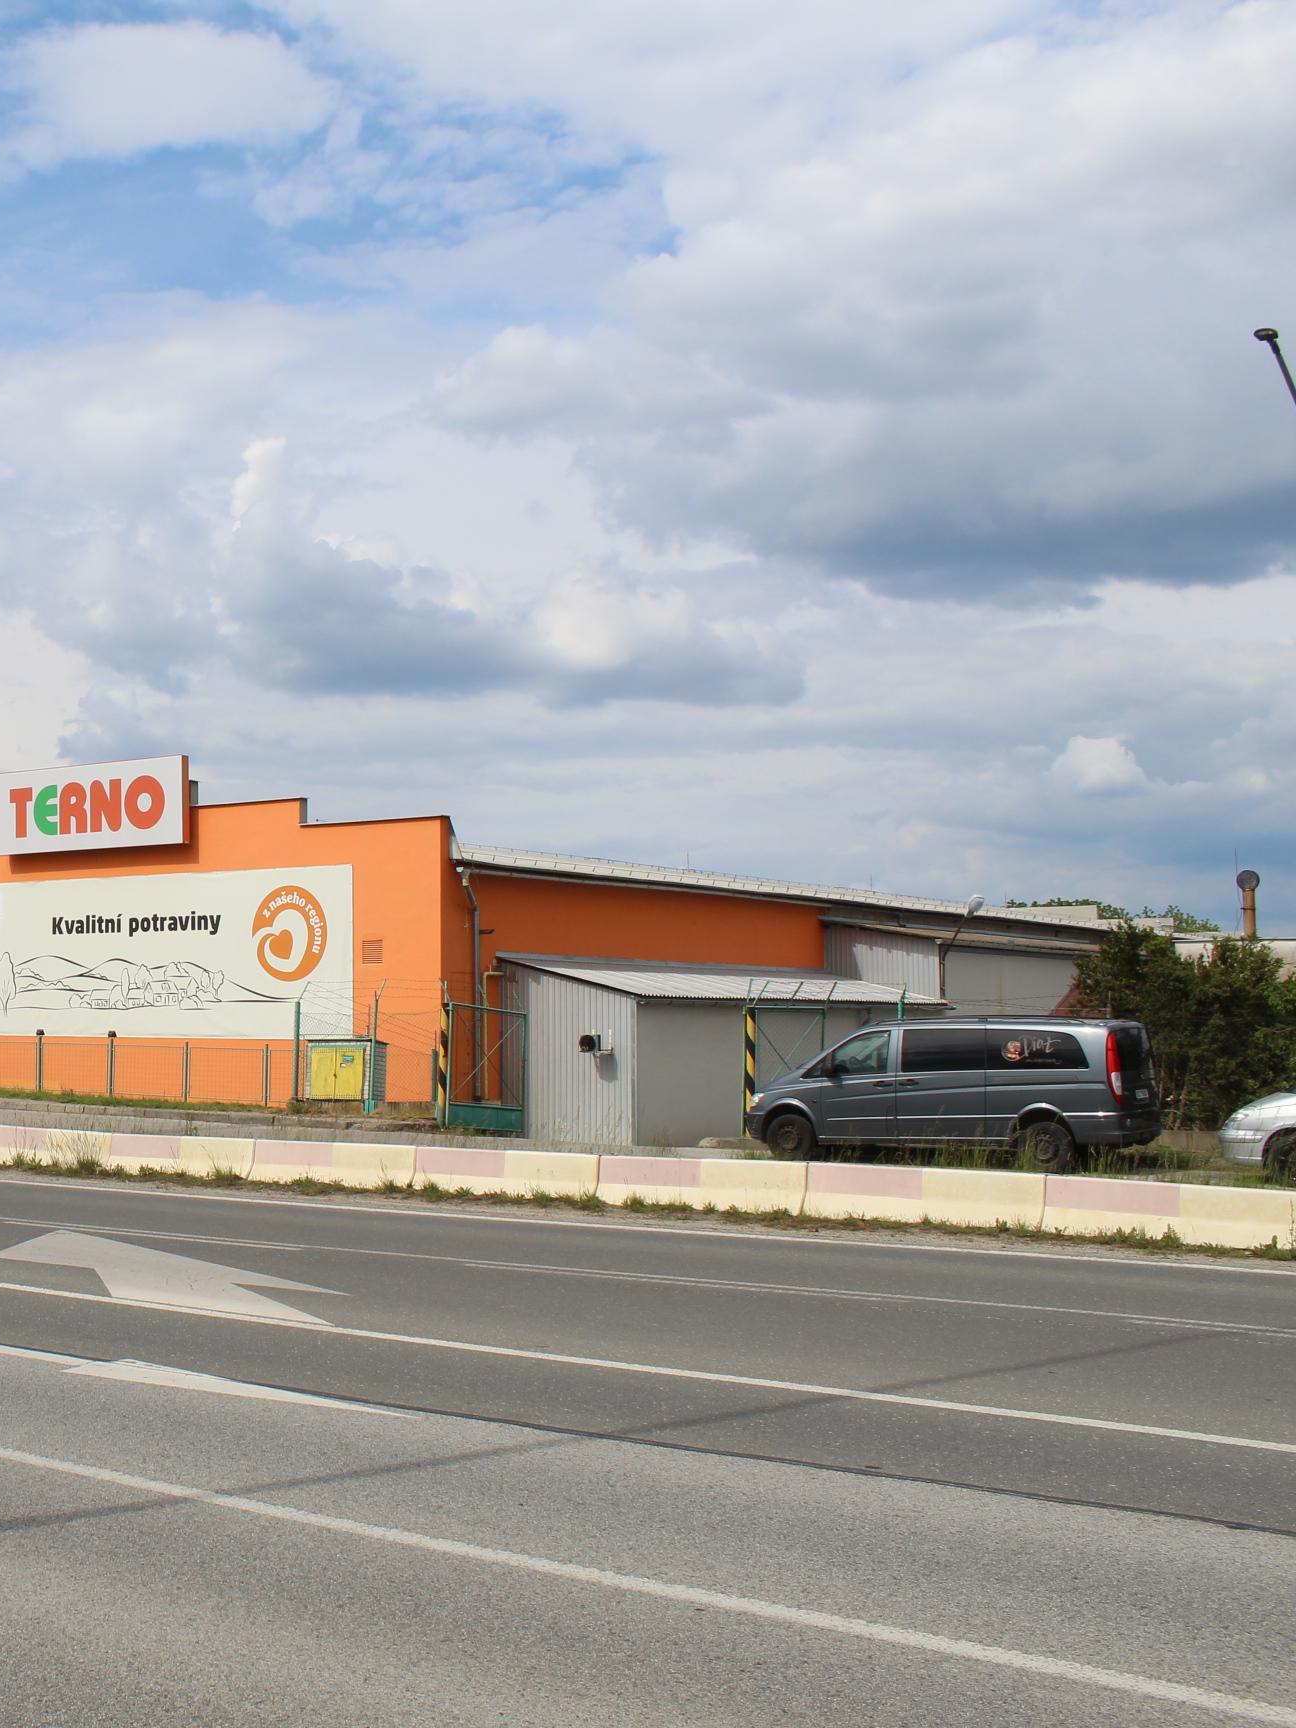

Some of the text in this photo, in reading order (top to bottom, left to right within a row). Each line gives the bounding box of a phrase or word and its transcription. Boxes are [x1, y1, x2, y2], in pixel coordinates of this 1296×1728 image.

[9, 775, 165, 838] TERNO
[52, 911, 221, 937] Kvalitní potraviny
[263, 890, 324, 954] z našeho regionu
